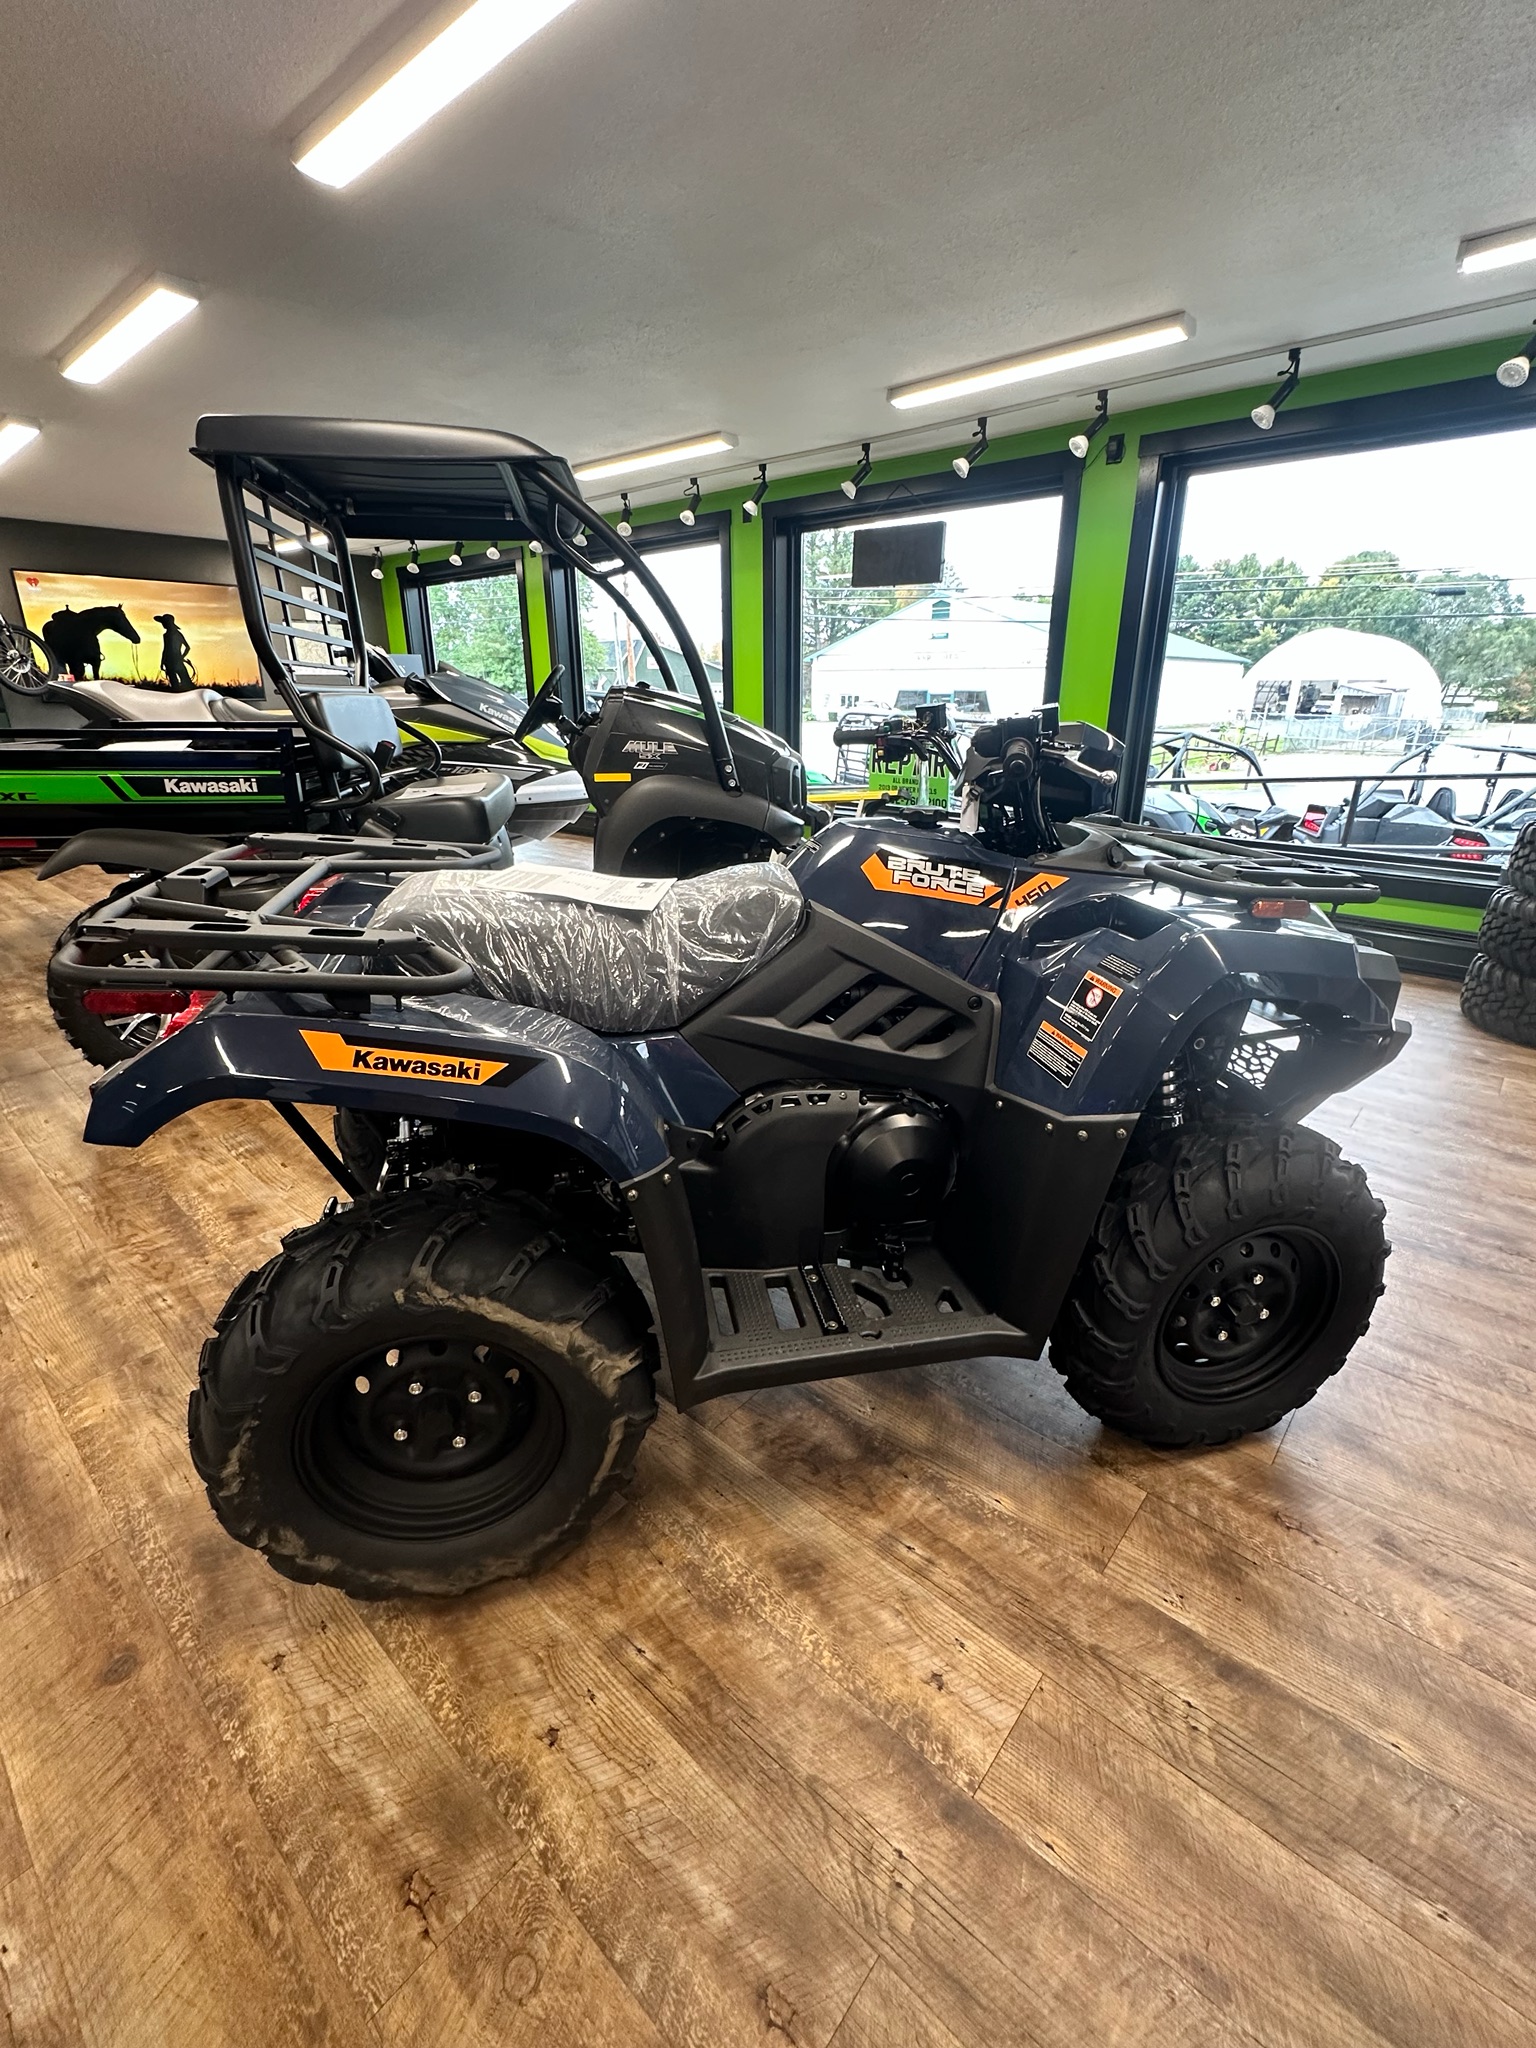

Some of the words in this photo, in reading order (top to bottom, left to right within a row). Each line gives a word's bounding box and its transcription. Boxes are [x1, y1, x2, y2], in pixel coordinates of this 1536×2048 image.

[479, 702, 520, 727] Kawasa
[622, 740, 678, 754] MULE
[163, 778, 258, 793] Kawasaki
[902, 777, 919, 785] BRAND
[0, 792, 39, 801] XC
[887, 856, 981, 880] BRUTE
[892, 870, 986, 898] FORCE
[1015, 881, 1051, 906] 450
[1094, 978, 1118, 994] WARNING
[352, 1049, 482, 1081] Kawasaki
